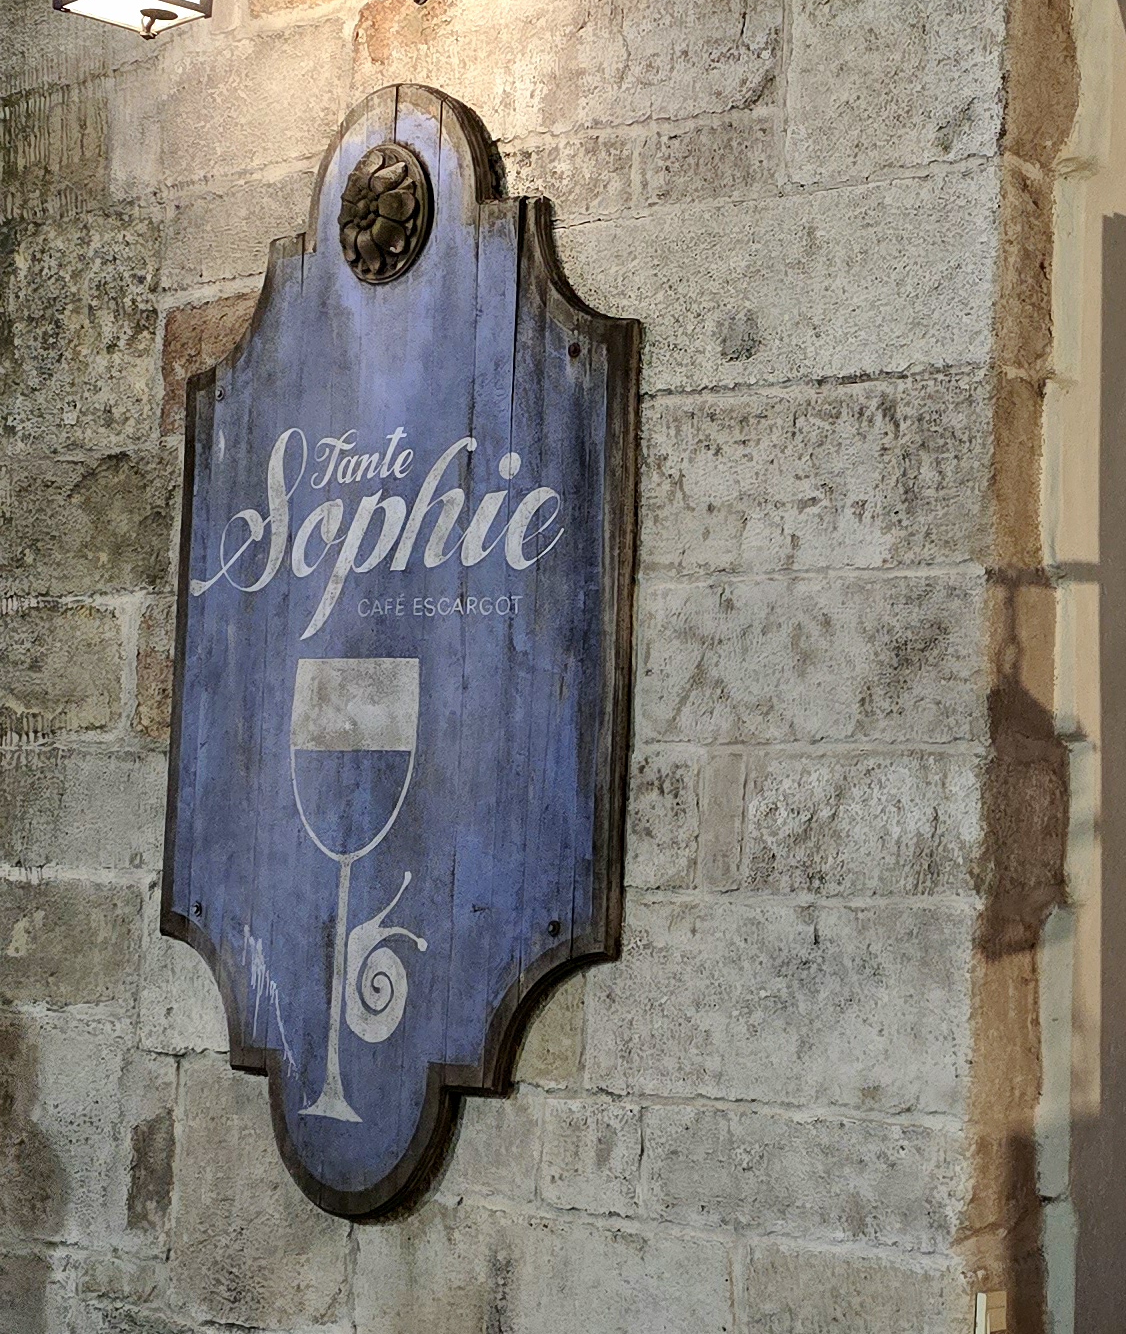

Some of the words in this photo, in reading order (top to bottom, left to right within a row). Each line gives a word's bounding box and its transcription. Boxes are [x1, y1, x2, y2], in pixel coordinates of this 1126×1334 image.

[310, 426, 415, 489] Tante
[189, 427, 565, 641] Sophie
[357, 593, 405, 617] CAFÉ
[413, 595, 524, 617] ESCARGOT
